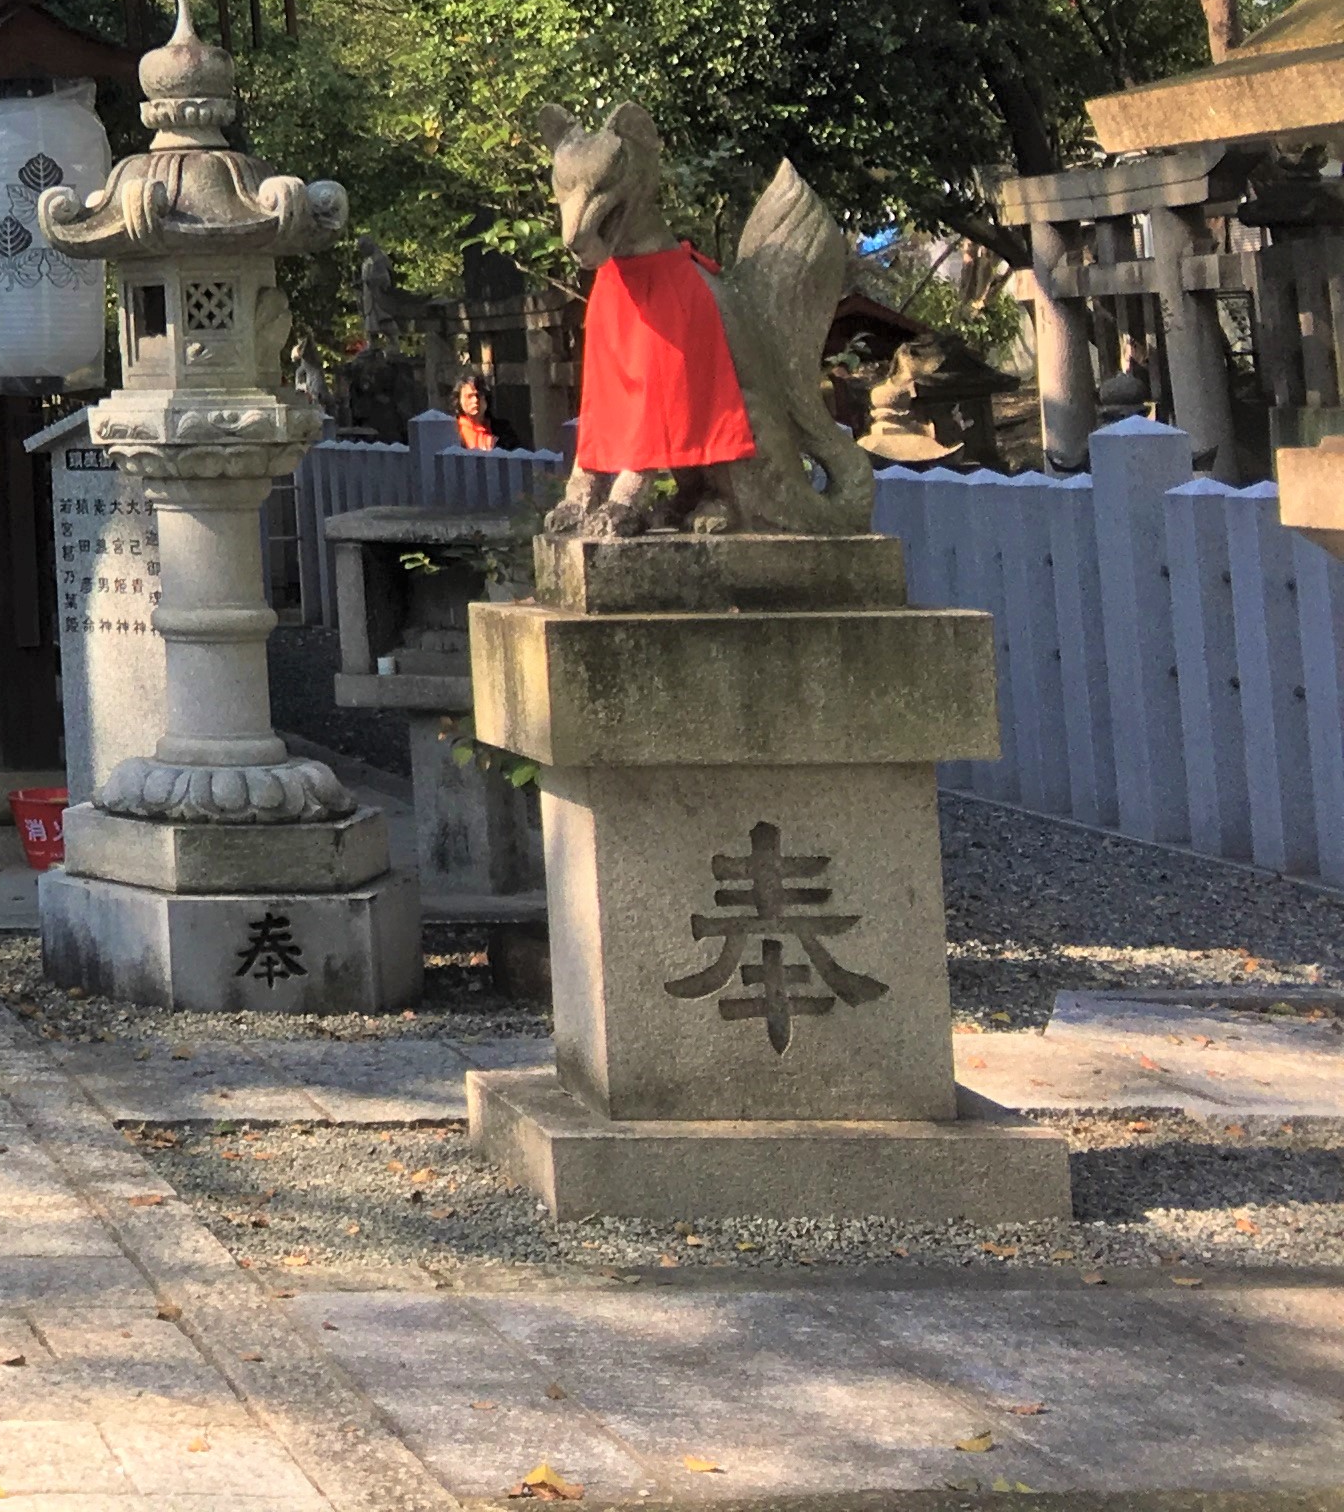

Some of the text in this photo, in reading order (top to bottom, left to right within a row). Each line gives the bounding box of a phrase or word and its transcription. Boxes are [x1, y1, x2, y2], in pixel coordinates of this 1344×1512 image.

[127, 499, 147, 636] 大己貴神
[235, 911, 308, 989] 奉
[663, 820, 891, 1057] 奉
